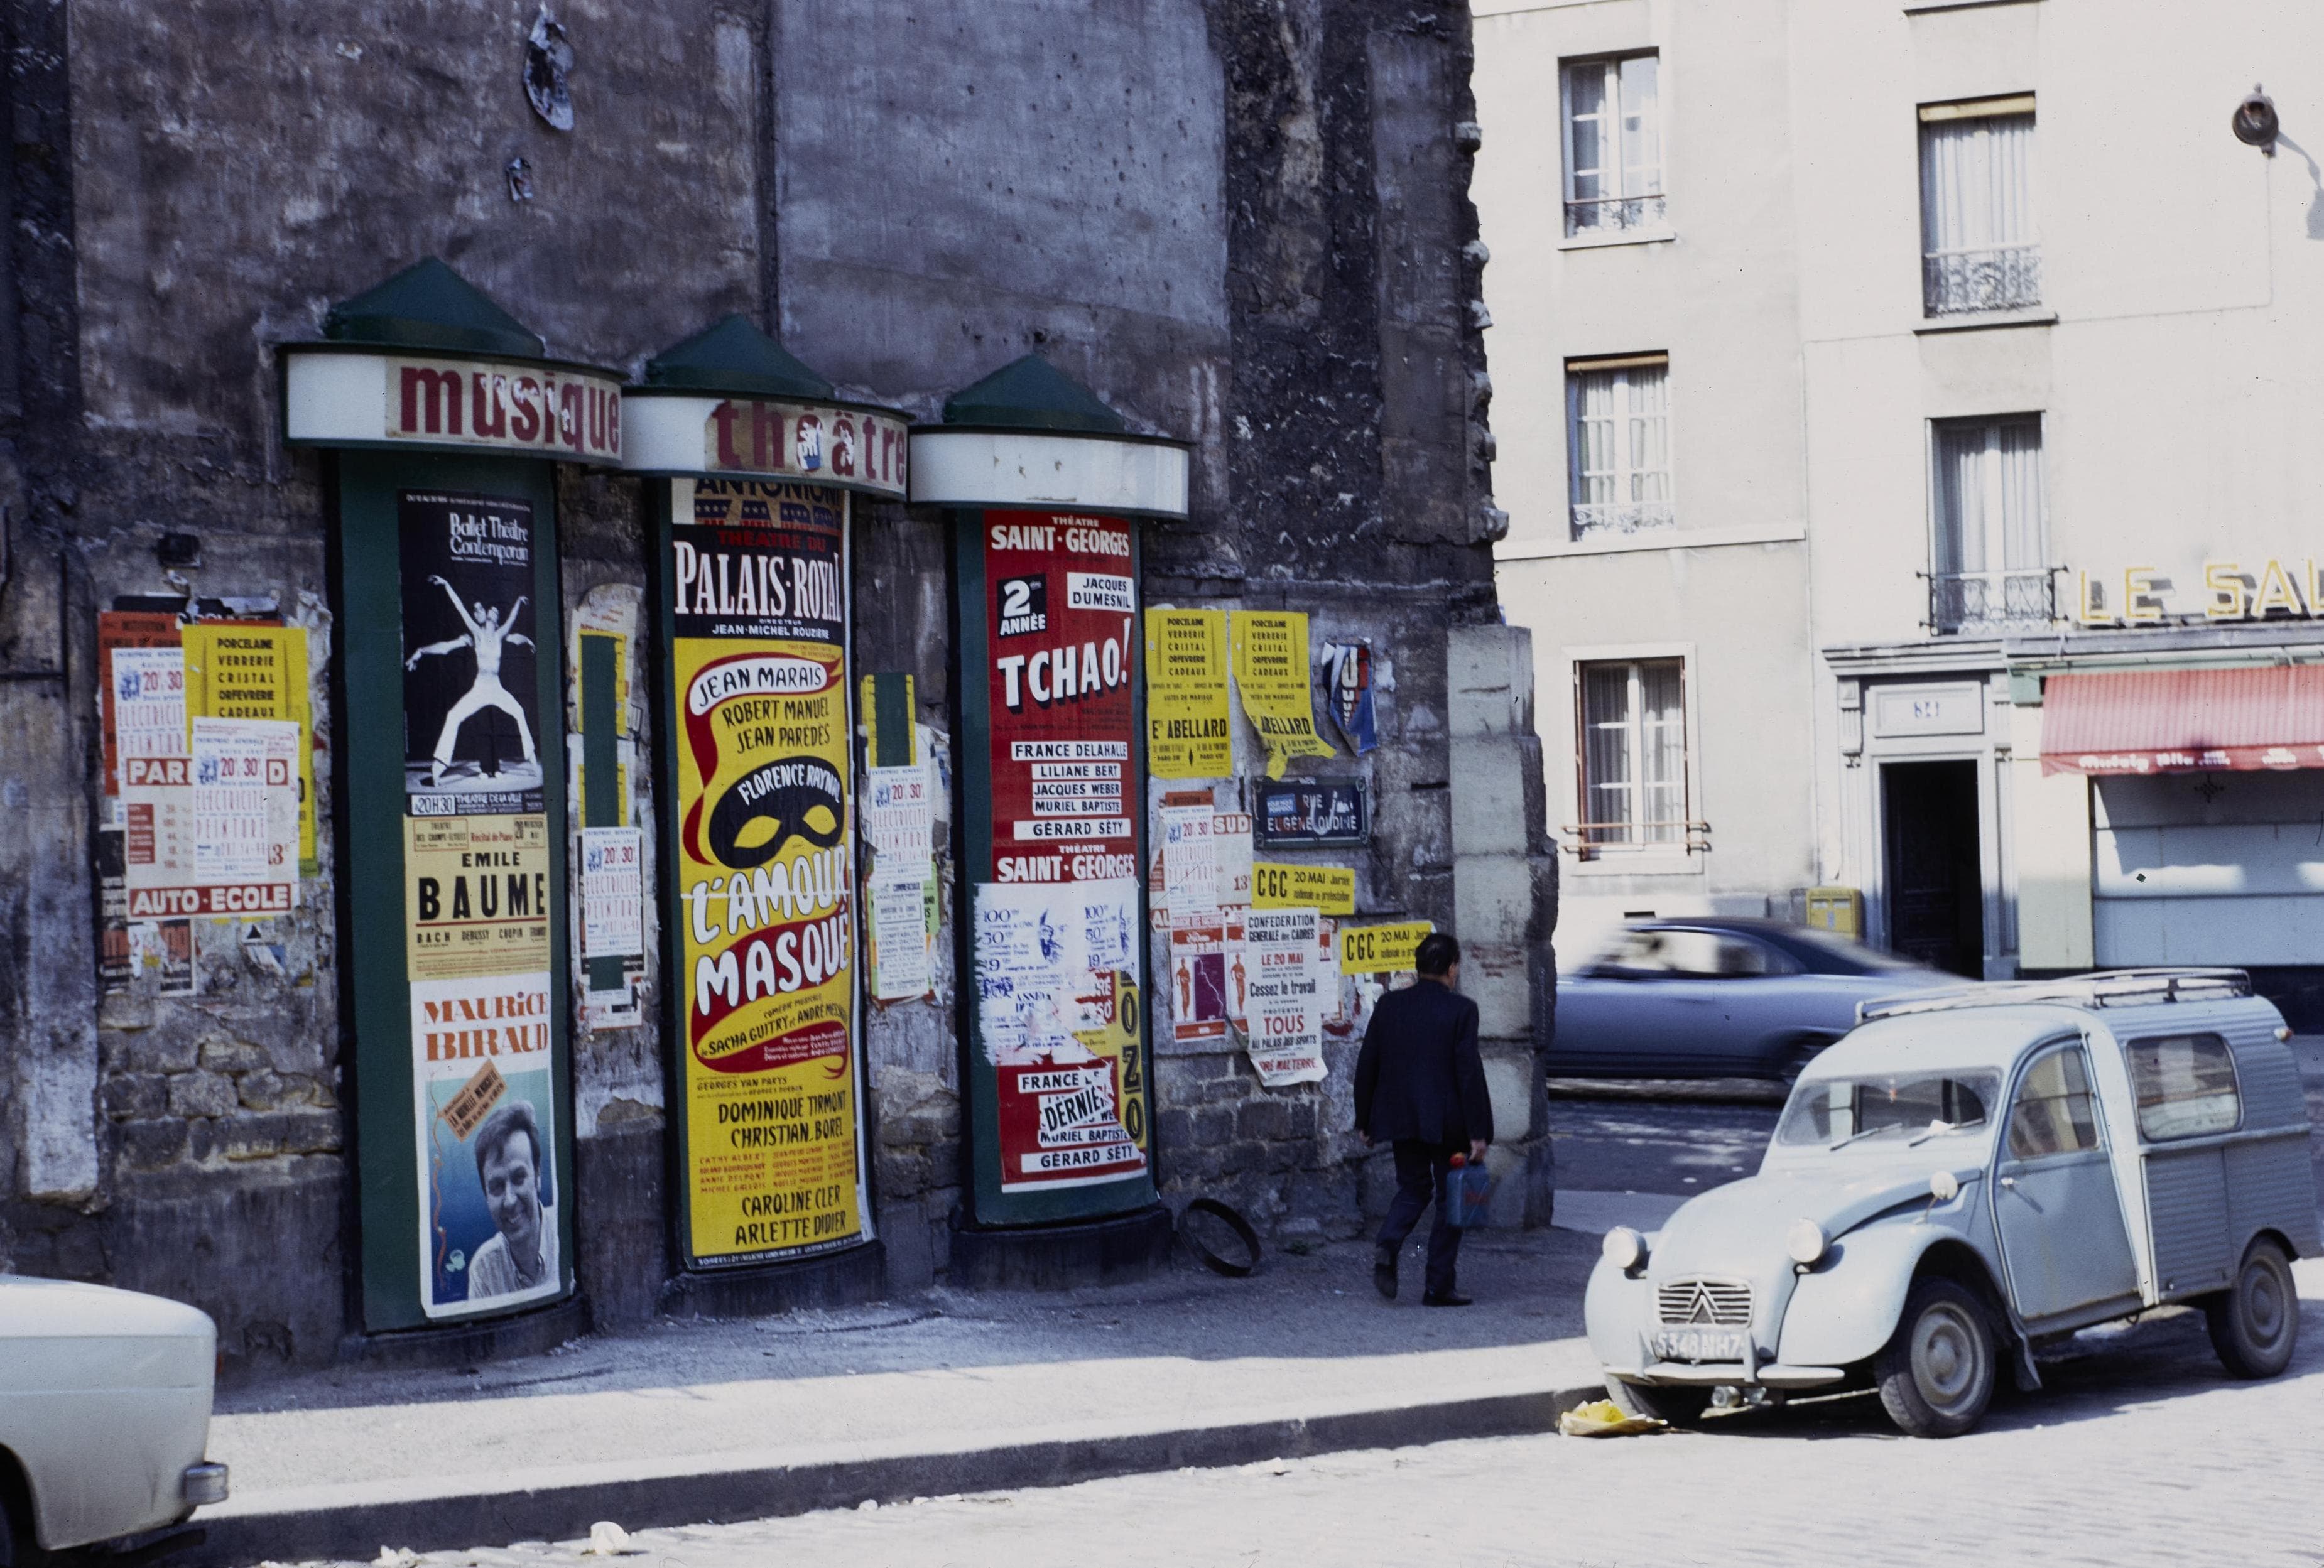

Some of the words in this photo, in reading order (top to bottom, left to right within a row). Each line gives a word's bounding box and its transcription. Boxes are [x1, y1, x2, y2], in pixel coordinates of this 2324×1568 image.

[401, 366, 619, 453] musique
[449, 512, 487, 538] Ballet
[1083, 578, 1127, 592] JACQUES
[1073, 592, 1131, 608] DUMESNIL
[2080, 566, 2160, 622] LE
[1000, 613, 1046, 637] ANNÉE
[1167, 618, 1204, 627] PORCELAINE
[1251, 620, 1286, 628] PORCELAINE
[1168, 630, 1205, 639] VERRERIE
[1252, 632, 1287, 641] VERRERIE
[217, 638, 273, 650] PORCELAINE
[1168, 643, 1205, 651] CRISTAL
[1252, 644, 1288, 652] CRISTAL
[218, 656, 274, 667] VERRERIE
[217, 672, 274, 683] CRISTAL
[1168, 668, 1207, 676] CADEAUX
[1252, 668, 1289, 676] CADEAUX
[698, 668, 751, 707] JEAN
[757, 666, 822, 688] MARAIS
[219, 707, 275, 717] CADEAUX
[722, 700, 780, 728] ROBERT
[785, 696, 830, 720] MANUEL
[1167, 718, 1227, 740] ABELLARD
[737, 727, 774, 754] JEAN
[1015, 744, 1070, 757] FRANCE
[1076, 743, 1126, 757] DELAHALLE
[1041, 765, 1089, 777] LILIANE
[1095, 765, 1117, 776] BERT
[737, 764, 806, 806] FLORENCE
[1034, 784, 1086, 796] JACQUES
[1091, 783, 1121, 794] WEBER
[1035, 801, 1077, 812] MURIEL
[1082, 801, 1121, 813] BAPTISTE
[1033, 821, 1092, 836] GÉRARD
[1099, 819, 1124, 835] SÉTY
[1214, 816, 1250, 833] SUD
[462, 851, 521, 868] EMILE
[1257, 868, 1288, 898] CGC
[1294, 872, 1306, 883] 20
[1308, 871, 1327, 884] MAI
[418, 873, 545, 921] BAUME
[692, 843, 847, 945] L'AMOUR
[1249, 914, 1315, 928] CONFEDERATION
[417, 931, 450, 943] BACH
[462, 929, 490, 942] DEBUSSY
[499, 927, 523, 939] CHOPIN
[1249, 929, 1279, 943] GENERALE
[1381, 931, 1392, 943] 20
[1394, 930, 1409, 941] MAI
[1346, 932, 1374, 961] CGC
[696, 904, 849, 1016] MASQUÉ
[1261, 954, 1271, 966] LE
[1274, 953, 1285, 965] 20
[1288, 953, 1303, 964] MAI
[1249, 982, 1279, 997] Cessez
[1281, 980, 1288, 995] le
[1291, 978, 1316, 995] travail
[1264, 1014, 1304, 1036] TOUS
[423, 1022, 549, 1062] BIRAUD
[709, 1033, 747, 1056] SACHA
[750, 1015, 789, 1041] GUITRY
[1262, 1037, 1283, 1047] PALAIS
[697, 1079, 738, 1091] GEORGES
[741, 1079, 759, 1088] VAN
[1021, 1073, 1079, 1089] FRANCE
[718, 1097, 805, 1124] DOMINIQUE
[807, 1090, 847, 1117] TIRMONT
[730, 1122, 810, 1149] CHRISTIAN
[815, 1117, 844, 1140] BOREL
[1041, 1149, 1100, 1169] GÉRARD
[741, 1189, 812, 1217] CAROLINE
[815, 1184, 841, 1208] CLER
[735, 1217, 810, 1246] ARLETTE
[813, 1210, 847, 1236] DIDIER
